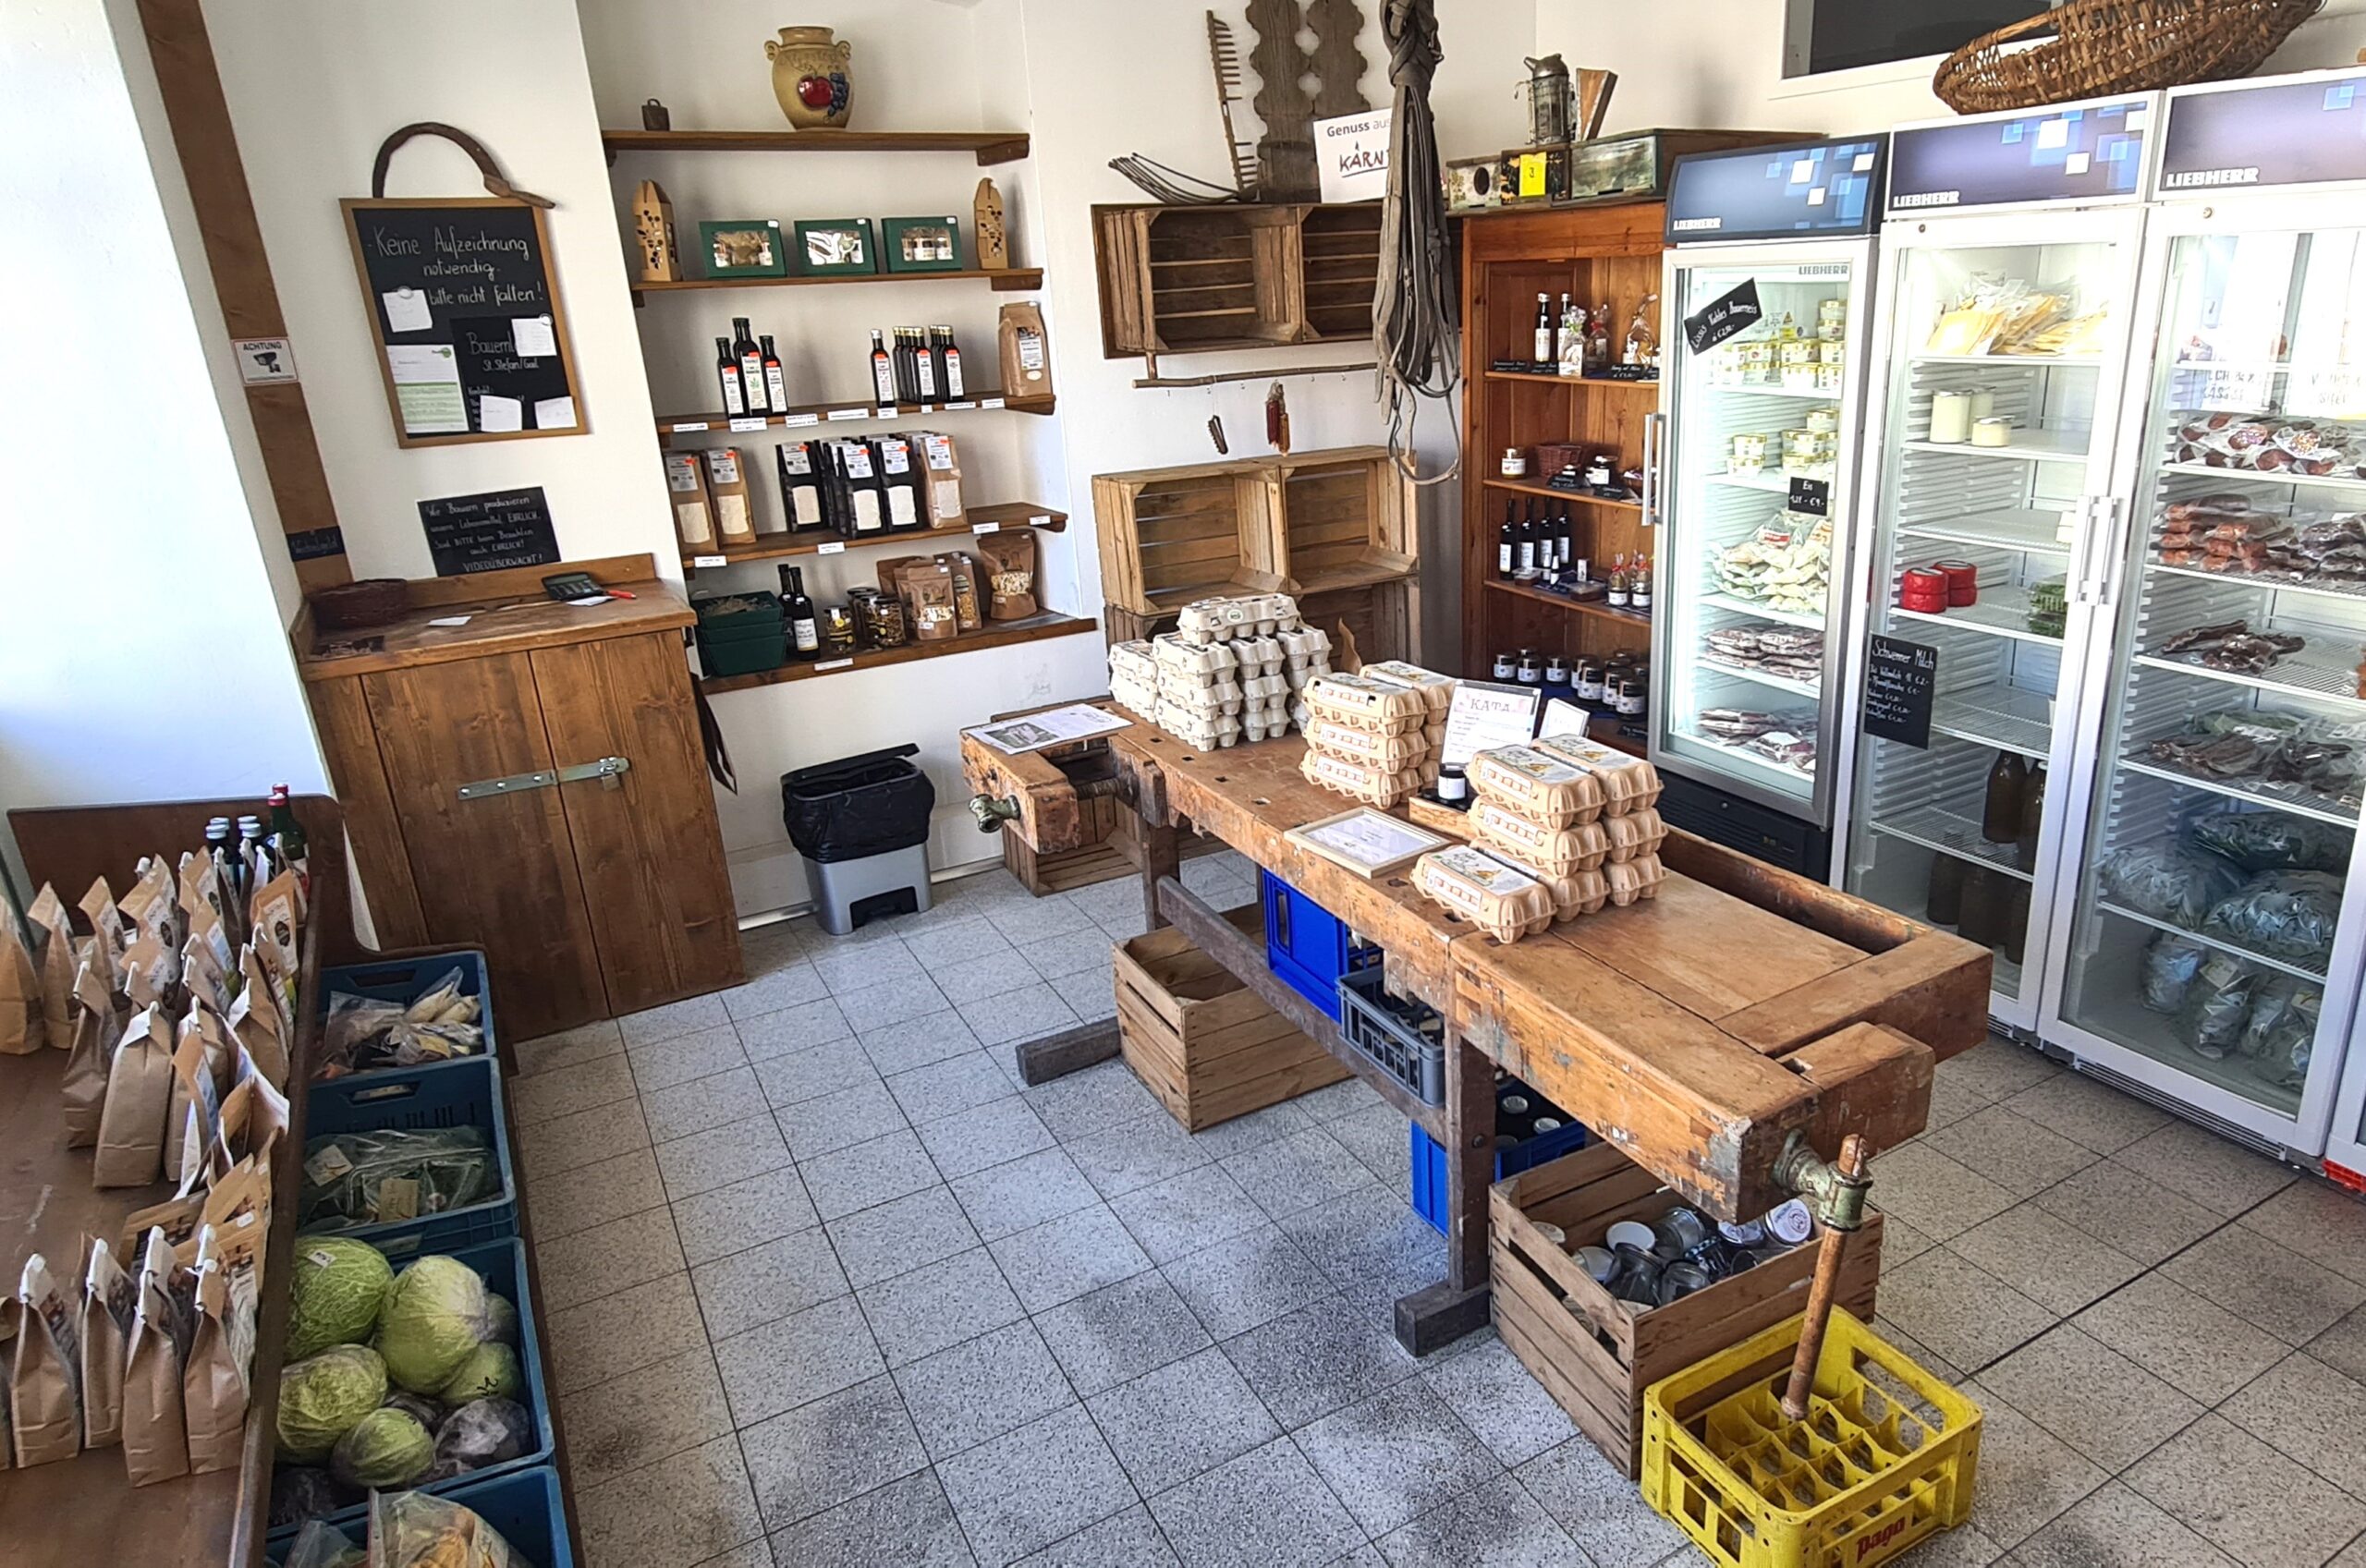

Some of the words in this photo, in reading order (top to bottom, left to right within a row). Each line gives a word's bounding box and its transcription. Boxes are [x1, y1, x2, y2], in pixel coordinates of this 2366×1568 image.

[1326, 121, 1370, 137] Genuss
[2165, 167, 2260, 188] LIEBHERR
[1893, 190, 1960, 208] LIEBHERR
[373, 226, 421, 257] Keine
[433, 225, 529, 261] Aufzeichnung
[1799, 265, 1848, 275] LIEBHERR
[427, 288, 454, 306] bitte
[457, 286, 485, 304] nicht
[243, 341, 282, 351] ACHTUNG
[466, 331, 516, 355] Bauernl
[1857, 1516, 1906, 1564] pago
